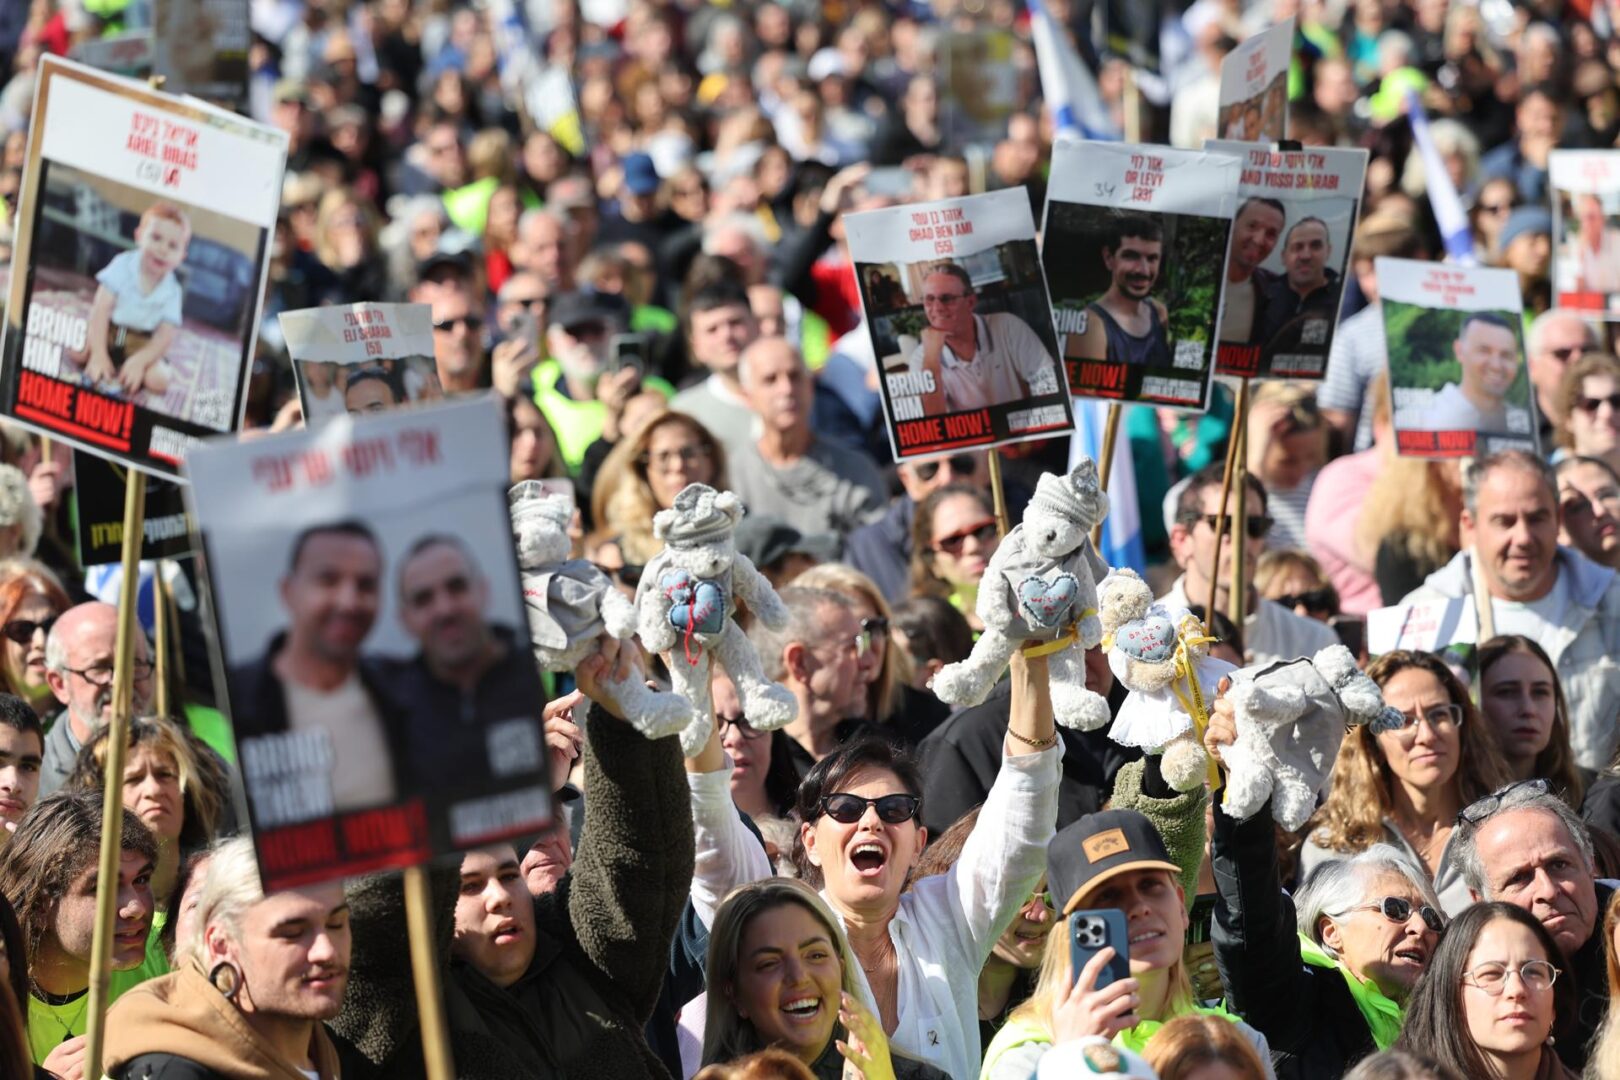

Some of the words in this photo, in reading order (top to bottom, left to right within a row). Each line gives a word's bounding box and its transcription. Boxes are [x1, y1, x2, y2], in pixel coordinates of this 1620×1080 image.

[1094, 182, 1116, 197] 34
[1125, 170, 1138, 184] OR
[1140, 172, 1164, 187] LEVY
[1240, 169, 1261, 185] AND
[1265, 171, 1294, 188] YOSSI
[935, 224, 953, 239] BEN
[955, 221, 974, 236] AMI
[26, 302, 88, 352] BRING
[1053, 309, 1088, 334] RING
[22, 337, 63, 379] HIM
[886, 370, 935, 397] BRING
[1081, 362, 1128, 389] NOW!
[18, 369, 75, 420] HOME
[75, 389, 134, 431] NOW!
[891, 395, 925, 421] HIM
[897, 419, 943, 447] HOME
[944, 408, 992, 440] NOW!
